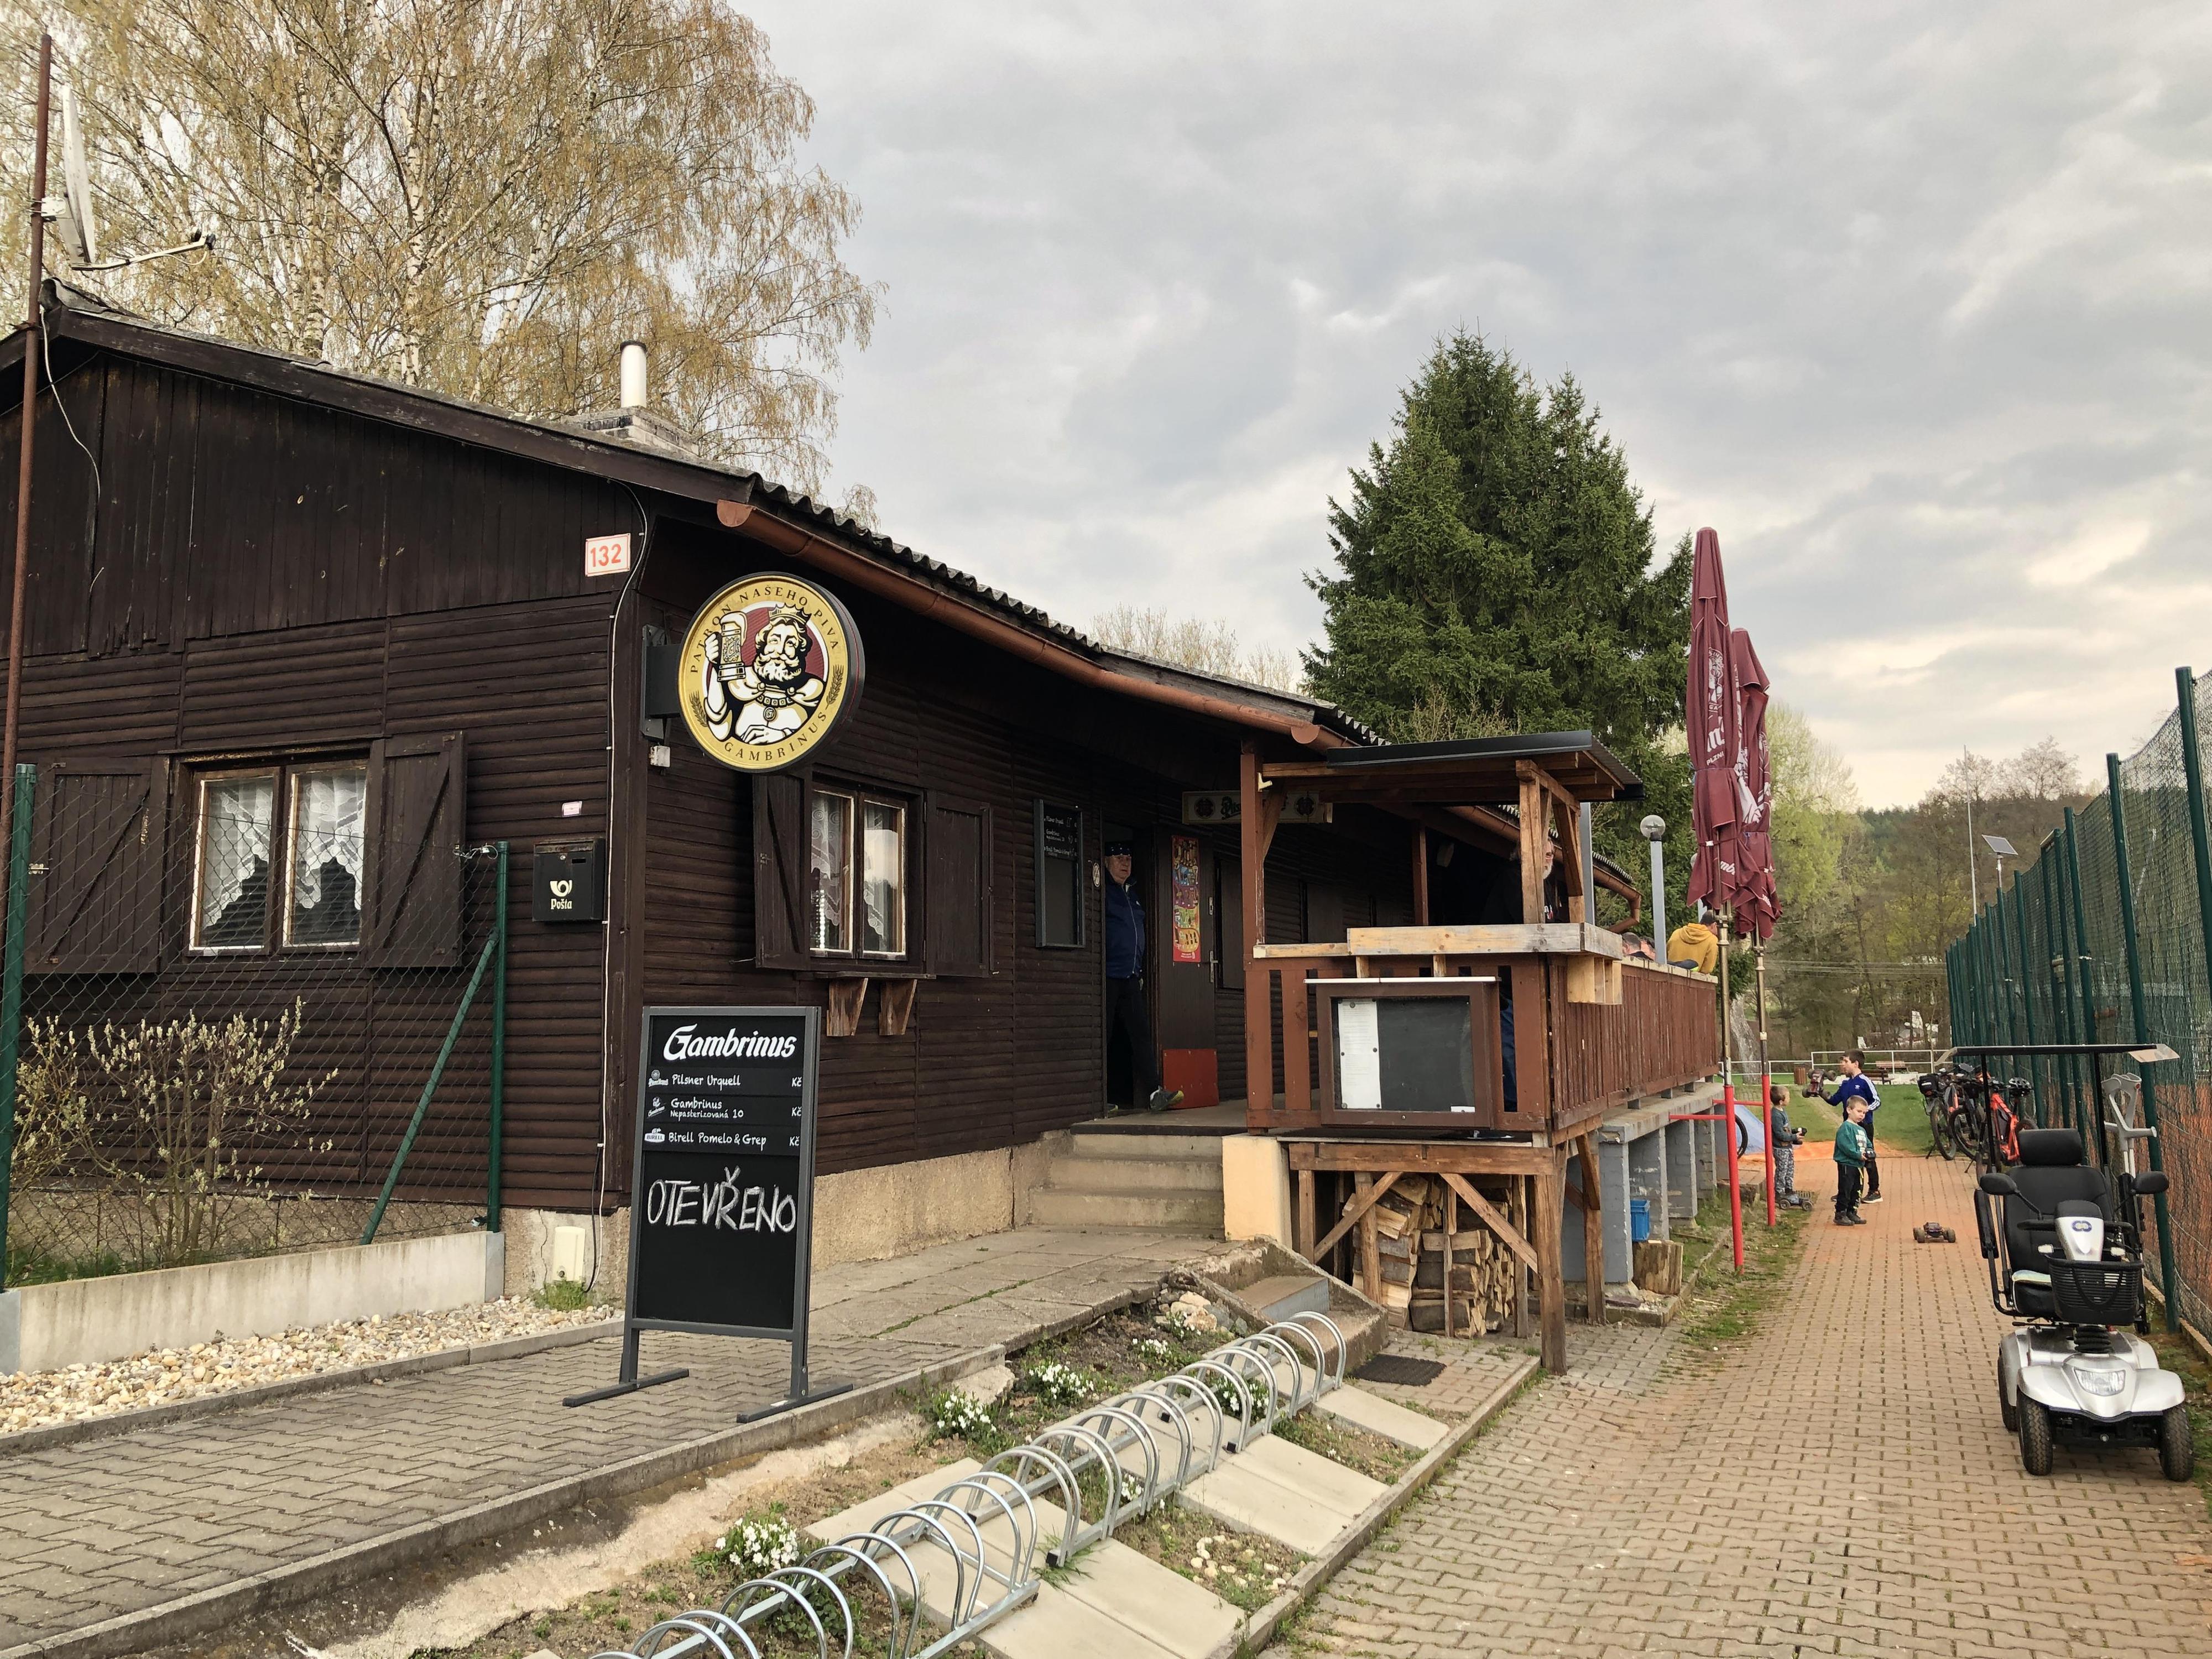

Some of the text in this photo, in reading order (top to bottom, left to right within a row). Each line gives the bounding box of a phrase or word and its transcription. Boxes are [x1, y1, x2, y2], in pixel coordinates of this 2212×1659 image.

[590, 543, 622, 567] 132
[690, 584, 839, 674] PATRON NAŠEHO PIVA
[724, 711, 827, 761] GAMBRINUS
[550, 898, 572, 910] Pošta
[664, 1023, 797, 1061] Gambrinus
[672, 1073, 704, 1085] Pilsner
[707, 1074, 741, 1091] Urquell
[791, 1077, 802, 1087] Kč
[670, 1096, 722, 1109] Gambrinus
[670, 1109, 729, 1122] Nepasterizovaná
[733, 1109, 744, 1118] 10
[791, 1107, 802, 1117] Kč
[669, 1131, 800, 1151] Birell Pomelo & Grep Kč
[647, 1165, 796, 1233] OTEVŘENO
